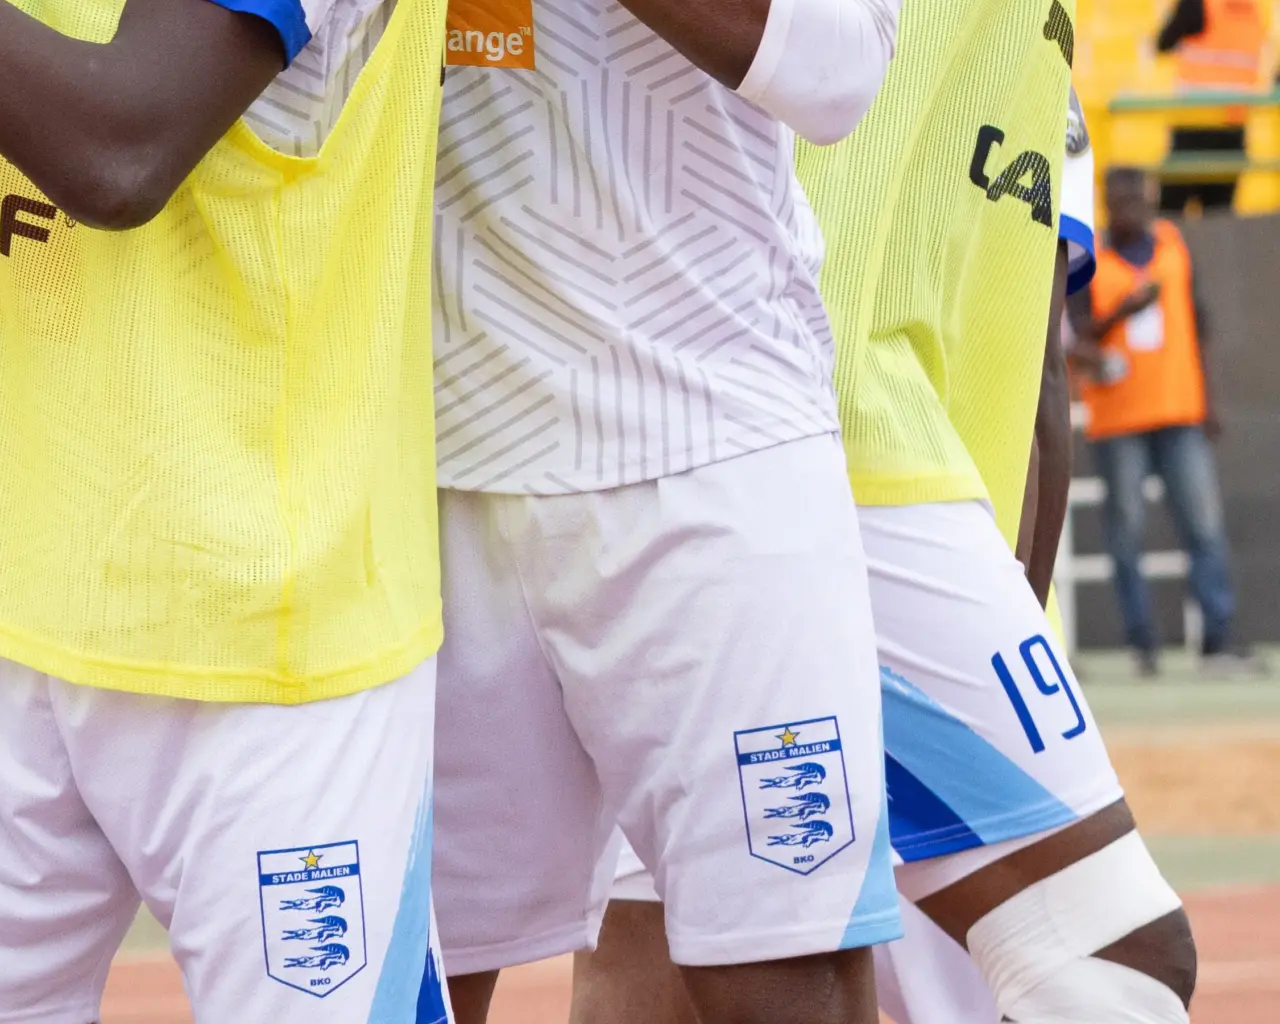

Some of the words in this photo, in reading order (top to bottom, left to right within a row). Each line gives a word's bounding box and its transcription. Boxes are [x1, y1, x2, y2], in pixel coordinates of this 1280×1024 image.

[969, 124, 1053, 229] CA
[990, 633, 1087, 754] 19
[750, 749, 787, 763] STADE
[789, 742, 831, 757] MALIEN
[793, 854, 815, 864] BKO
[272, 871, 309, 884] STADE
[311, 866, 350, 879] MALIEN
[310, 977, 331, 987] BKO
